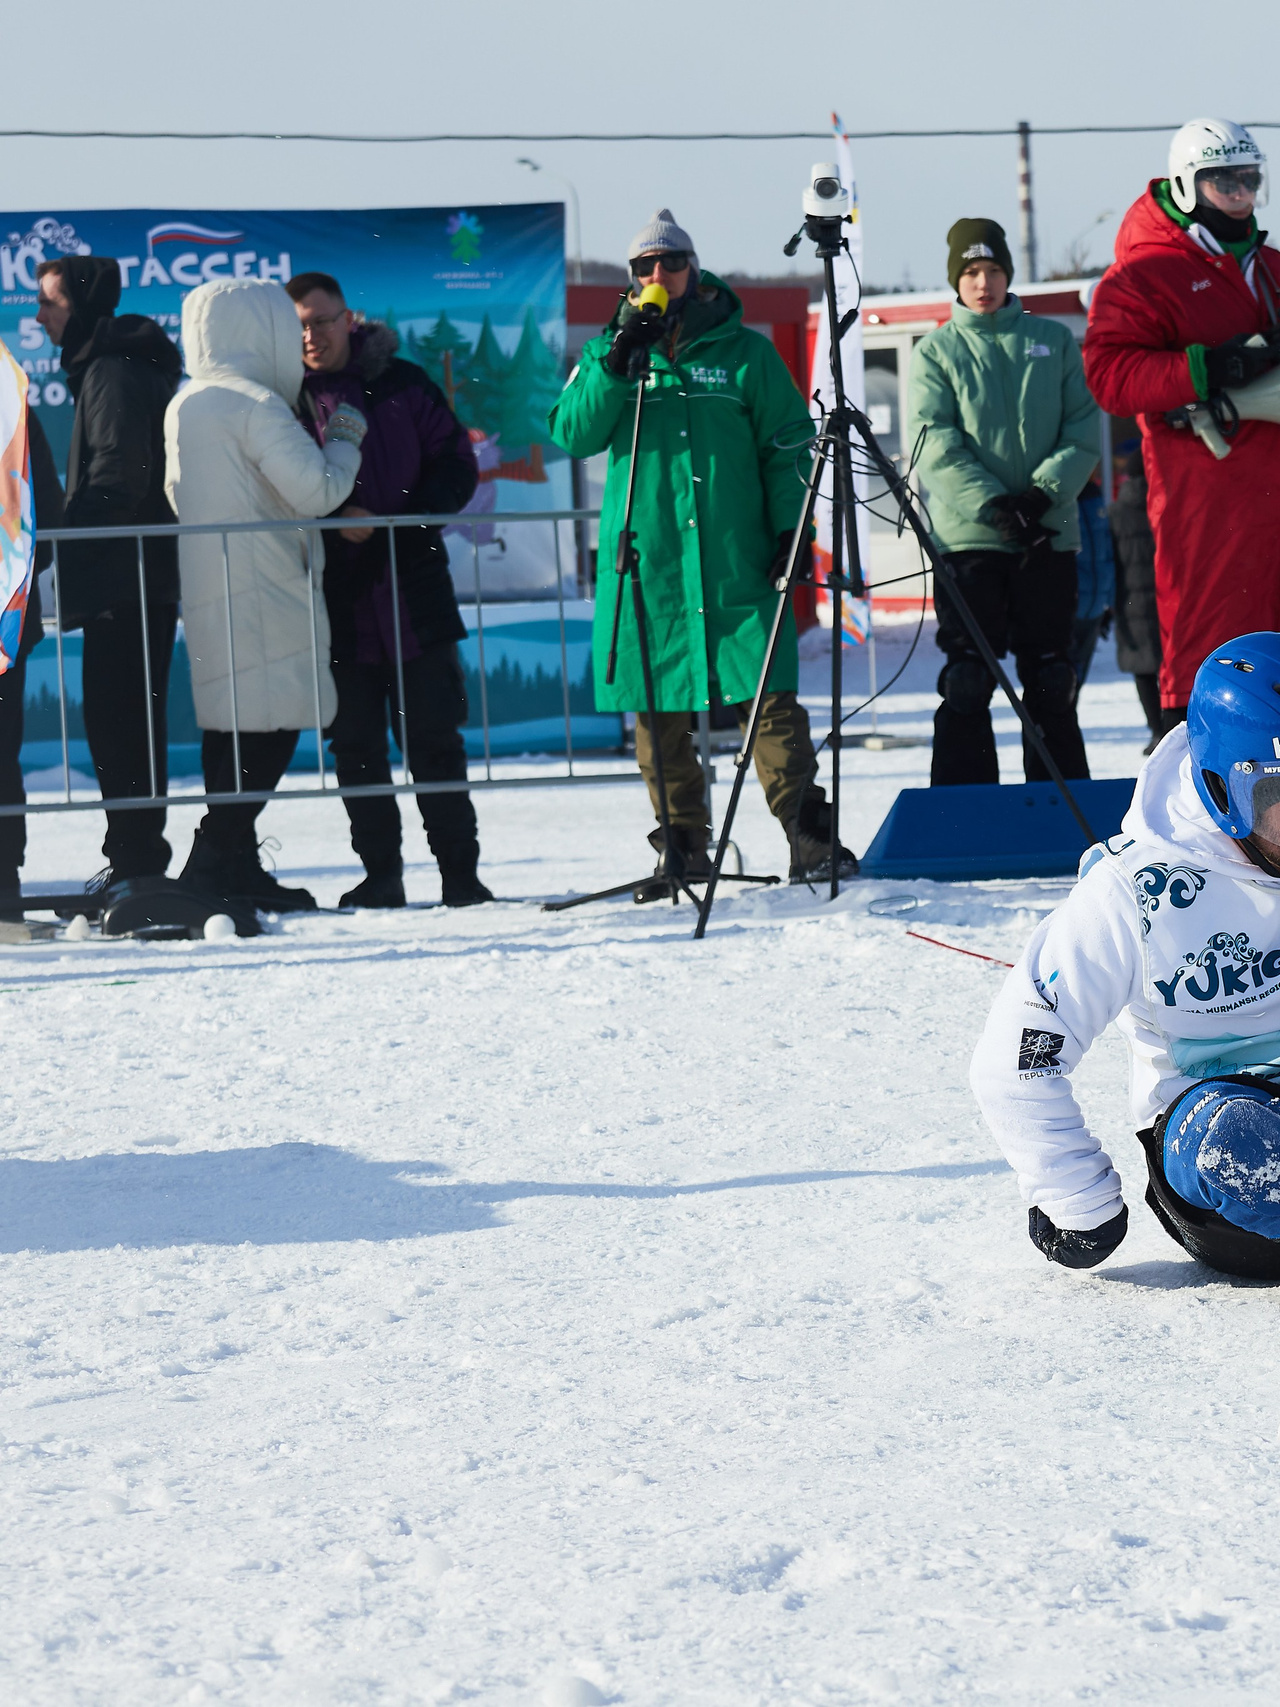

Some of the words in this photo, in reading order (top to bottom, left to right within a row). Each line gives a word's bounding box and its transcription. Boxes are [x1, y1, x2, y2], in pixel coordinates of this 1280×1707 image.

[0, 240, 293, 291] ЮГАССЕН
[1206, 994, 1258, 1014] MURMANSK
[1019, 1071, 1044, 1081] ГЕРЦ
[1045, 1068, 1062, 1077] ЭТМ
